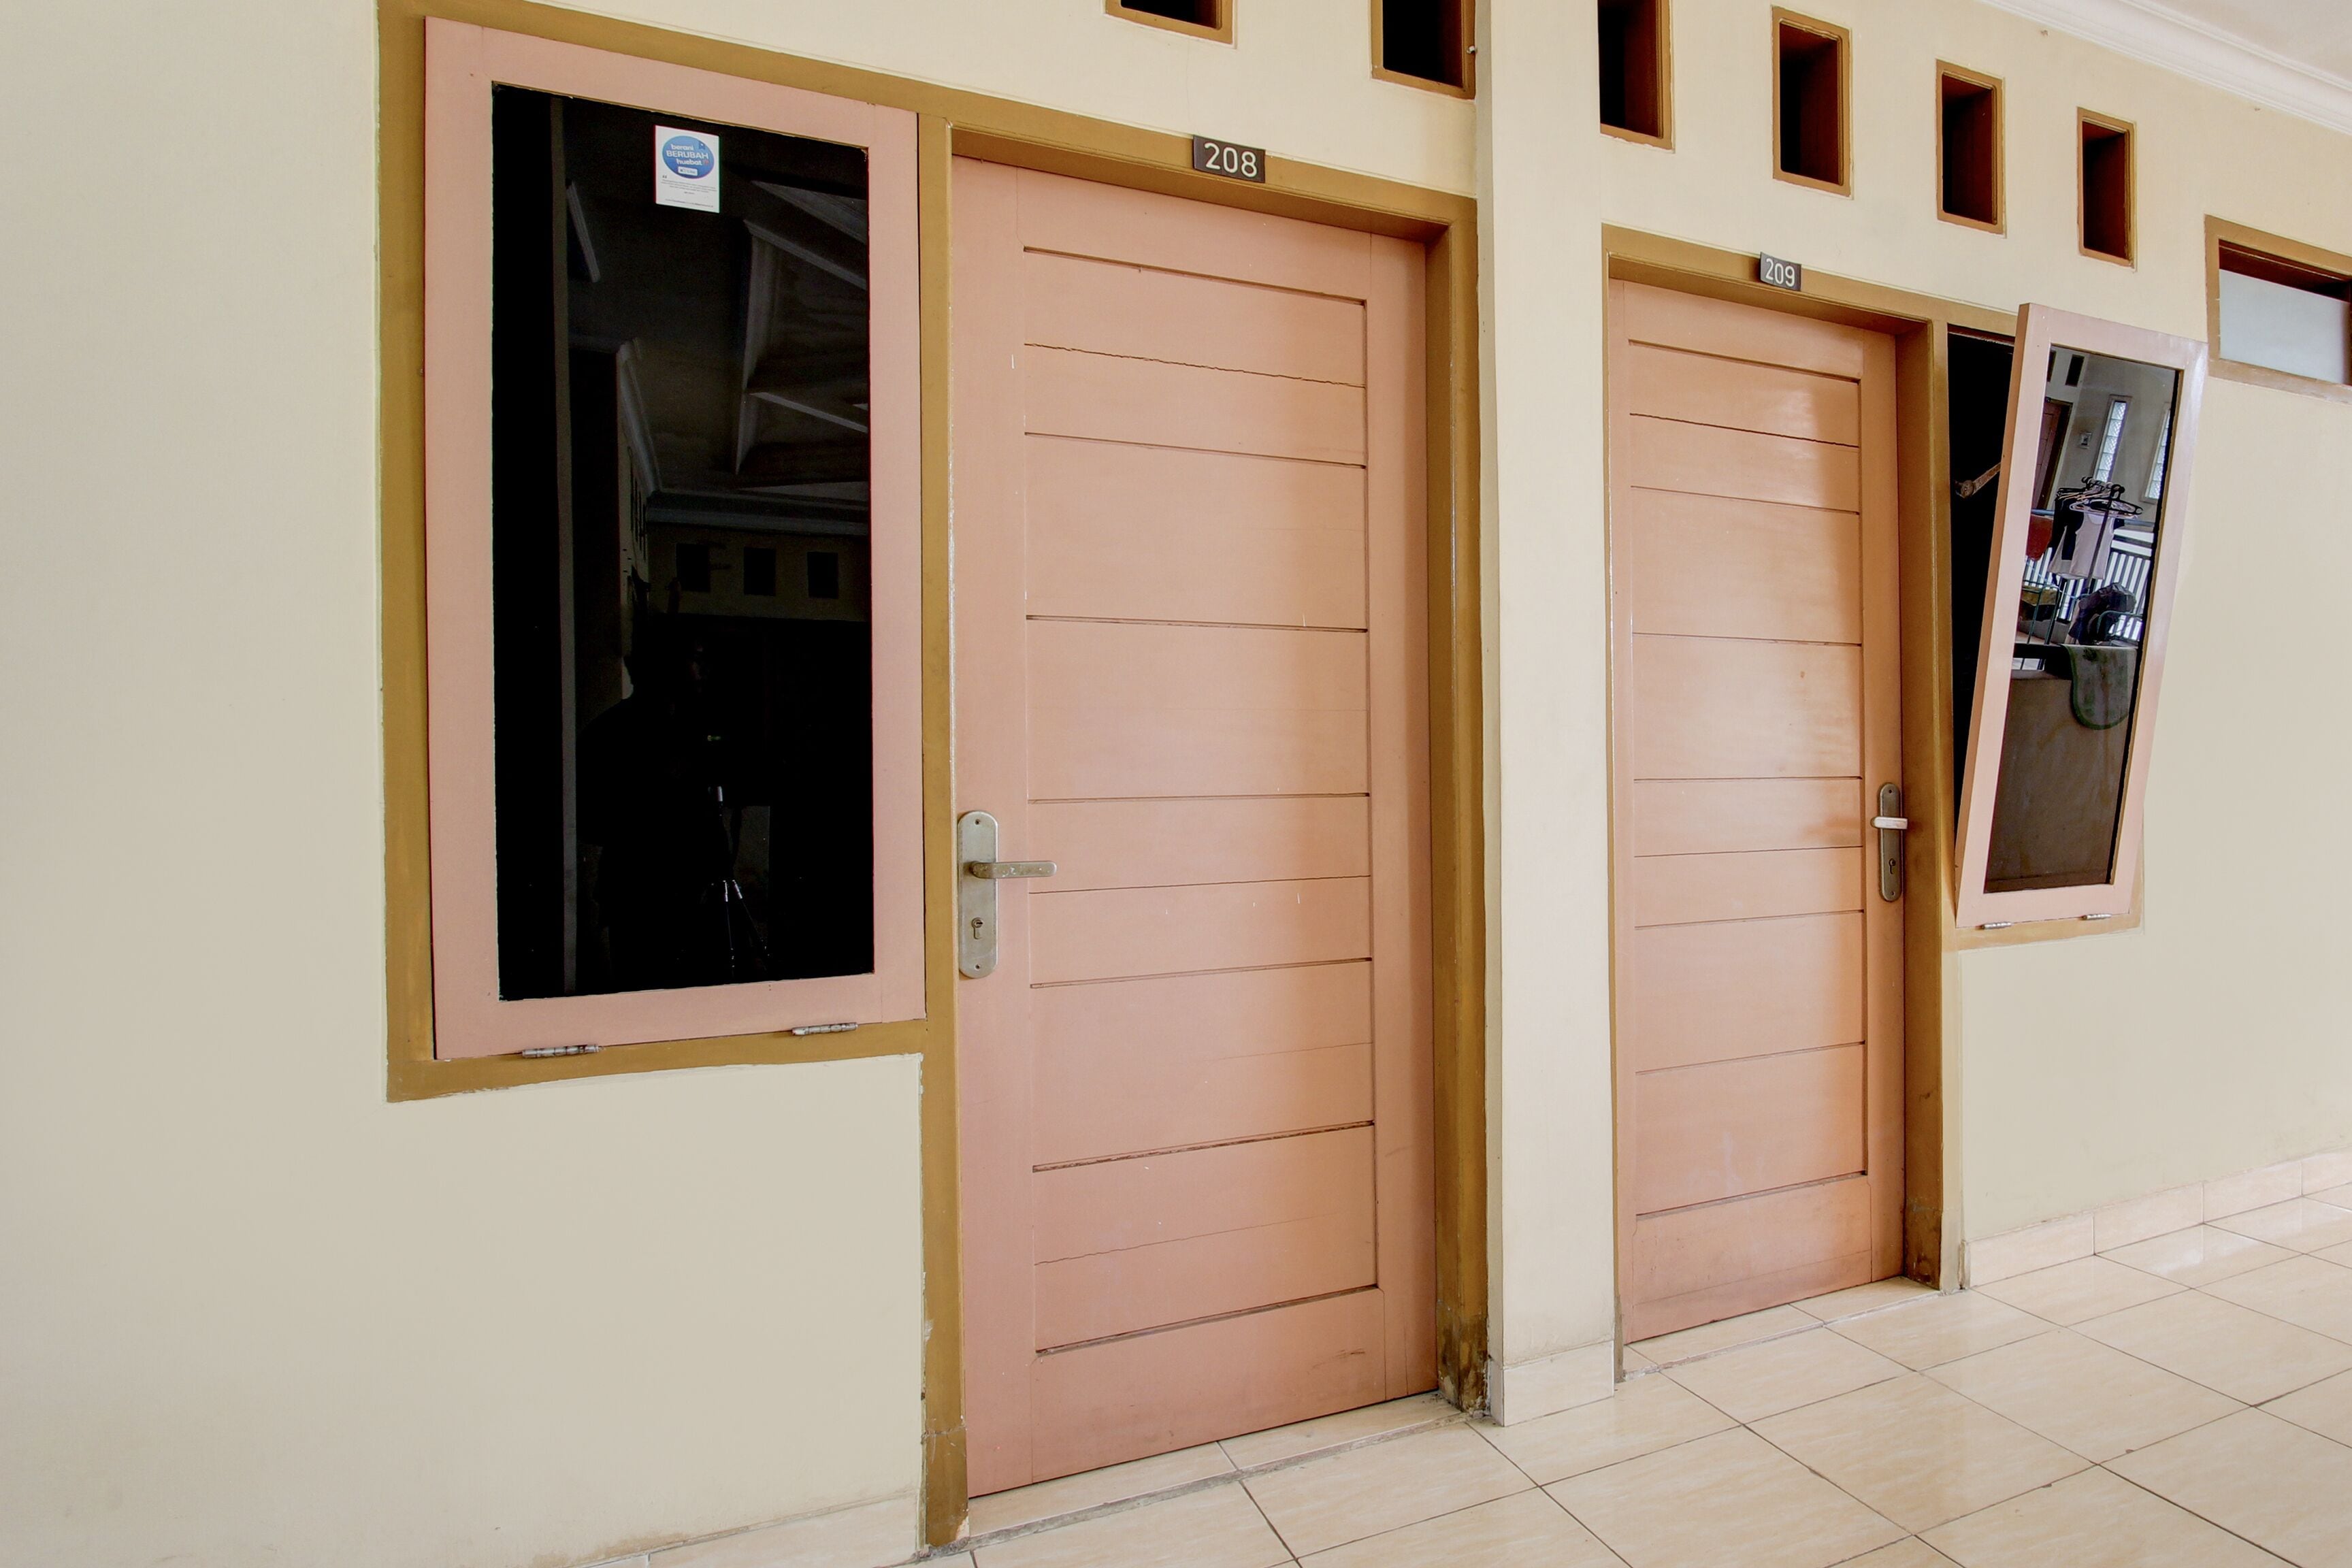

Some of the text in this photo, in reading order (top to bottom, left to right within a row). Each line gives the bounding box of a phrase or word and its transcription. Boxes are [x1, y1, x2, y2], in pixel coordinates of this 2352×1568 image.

[666, 150, 709, 159] BERUBAH
[1204, 142, 1258, 178] 208
[1765, 258, 1795, 287] 209
